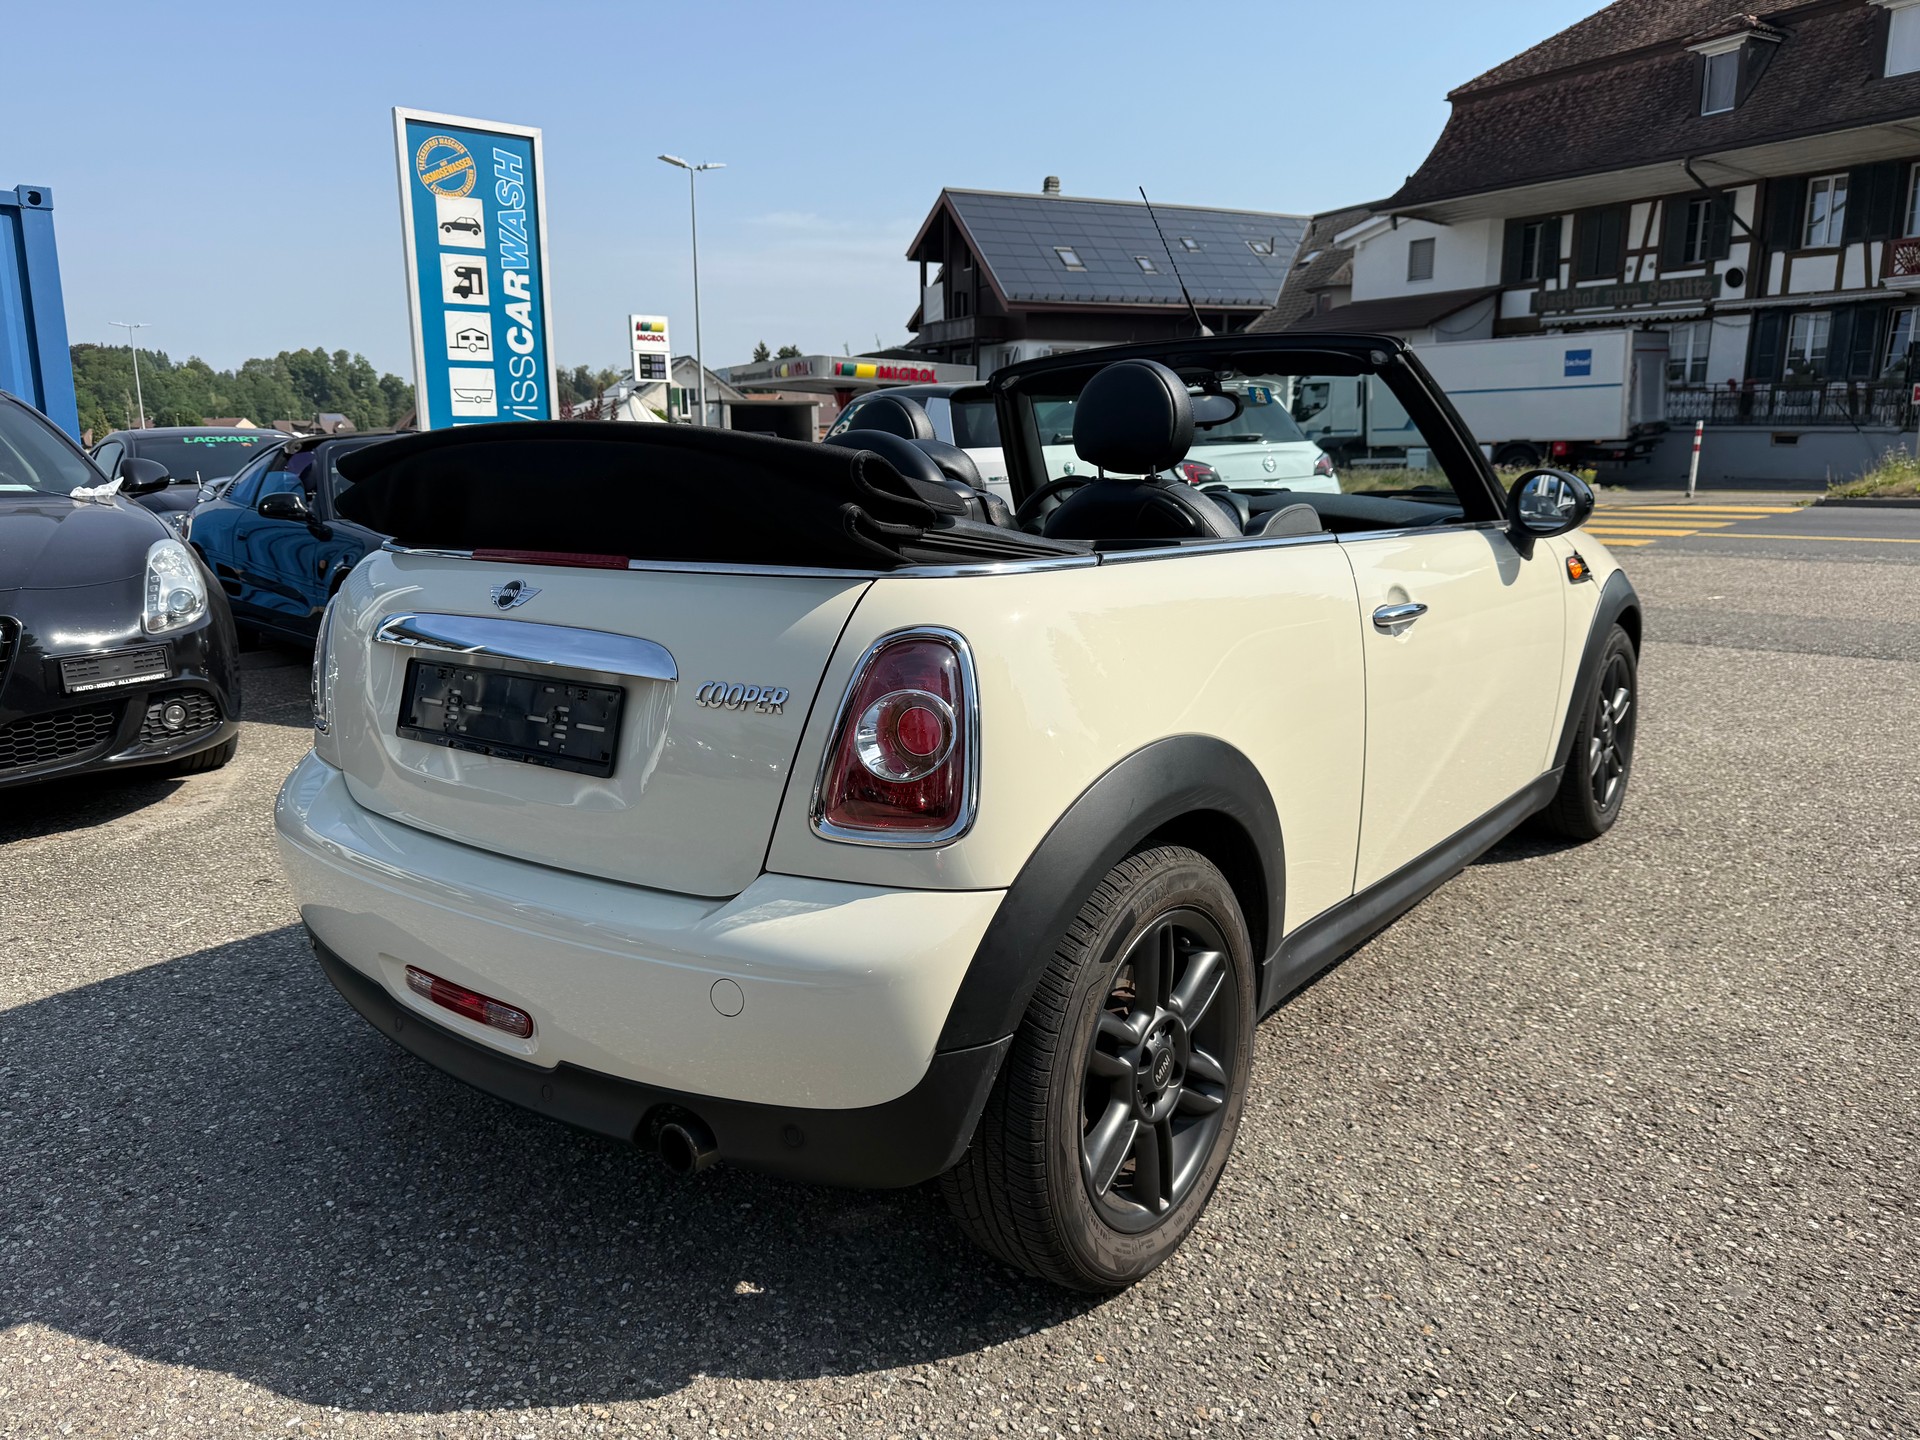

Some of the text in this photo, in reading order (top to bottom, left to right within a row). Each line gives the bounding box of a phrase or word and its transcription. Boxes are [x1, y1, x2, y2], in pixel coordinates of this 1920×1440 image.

[1536, 287, 1601, 309] Gasthof
[1604, 287, 1641, 304] zum
[636, 334, 666, 342] MIGROL
[878, 365, 938, 384] MIGROL
[183, 436, 260, 444] LACKART
[500, 588, 519, 597] MINI
[695, 680, 789, 715] COOPER
[1155, 1054, 1171, 1083] MINI
